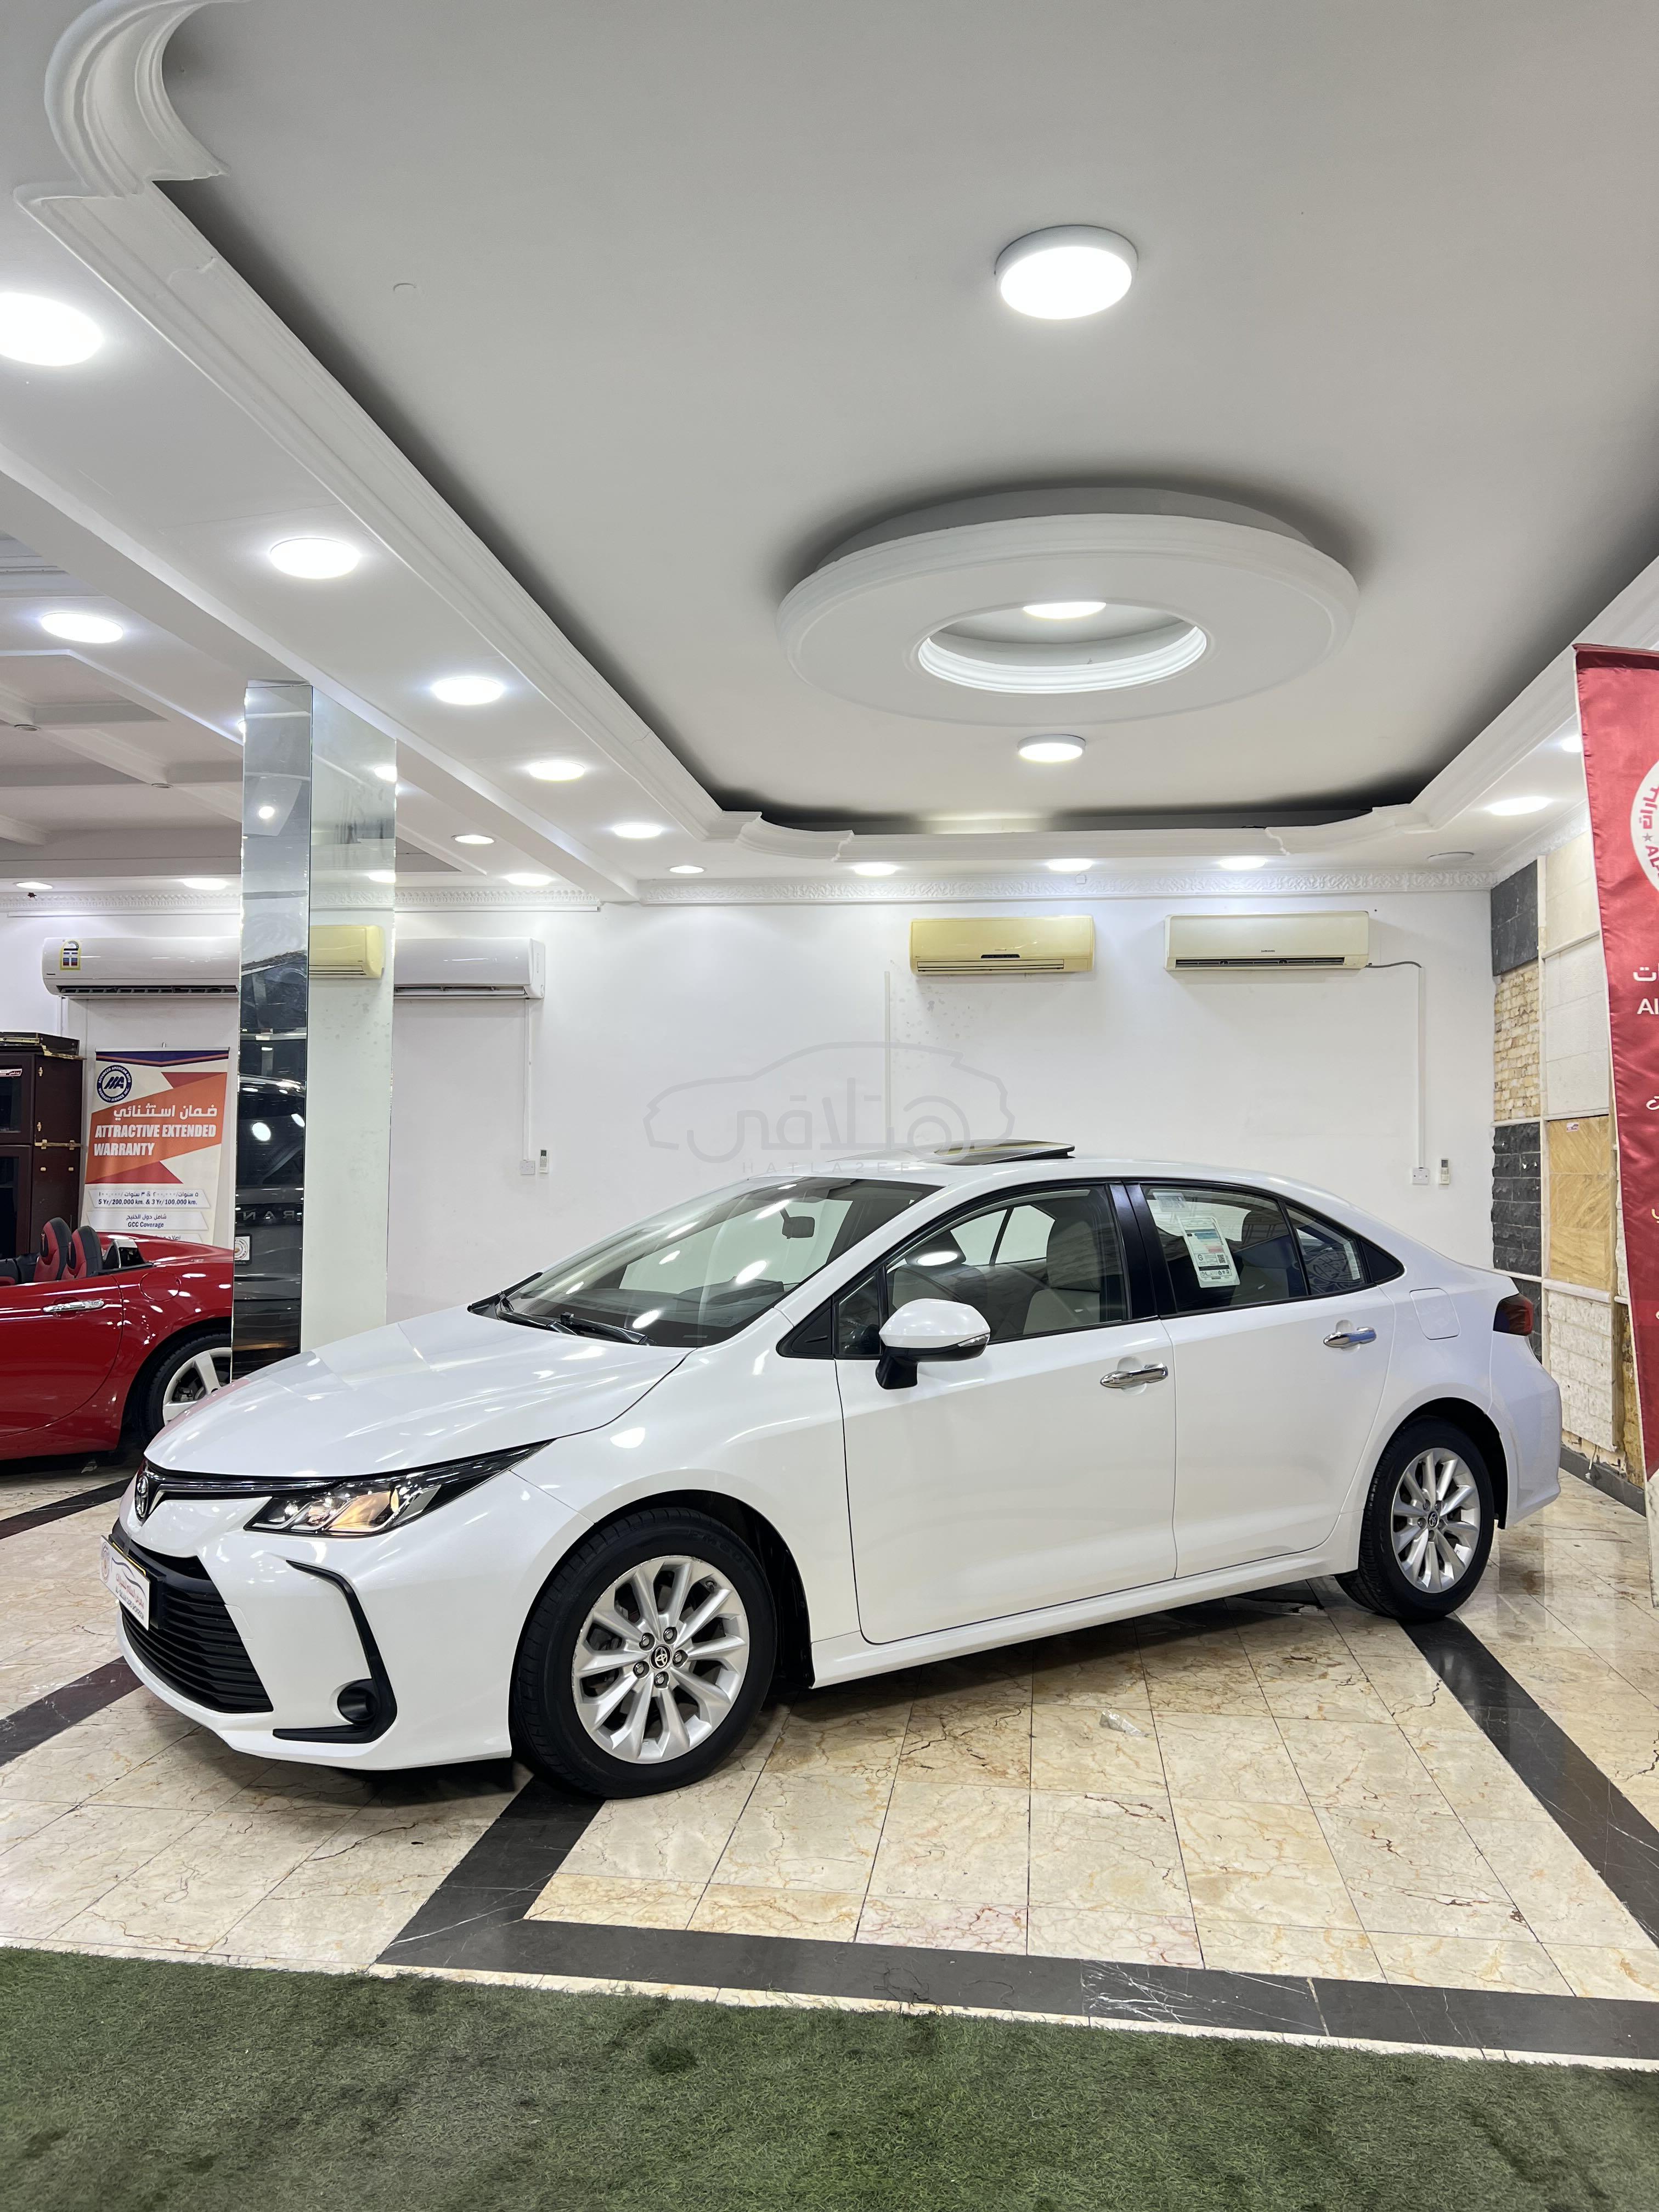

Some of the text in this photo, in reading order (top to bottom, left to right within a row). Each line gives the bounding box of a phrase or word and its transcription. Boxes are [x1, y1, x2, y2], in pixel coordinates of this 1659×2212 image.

[113, 1103, 218, 1121] ضمان استثنائي
[95, 1124, 216, 1138] ATTRACTIVE EXTENDED
[94, 1142, 155, 1156] WARRANTY
